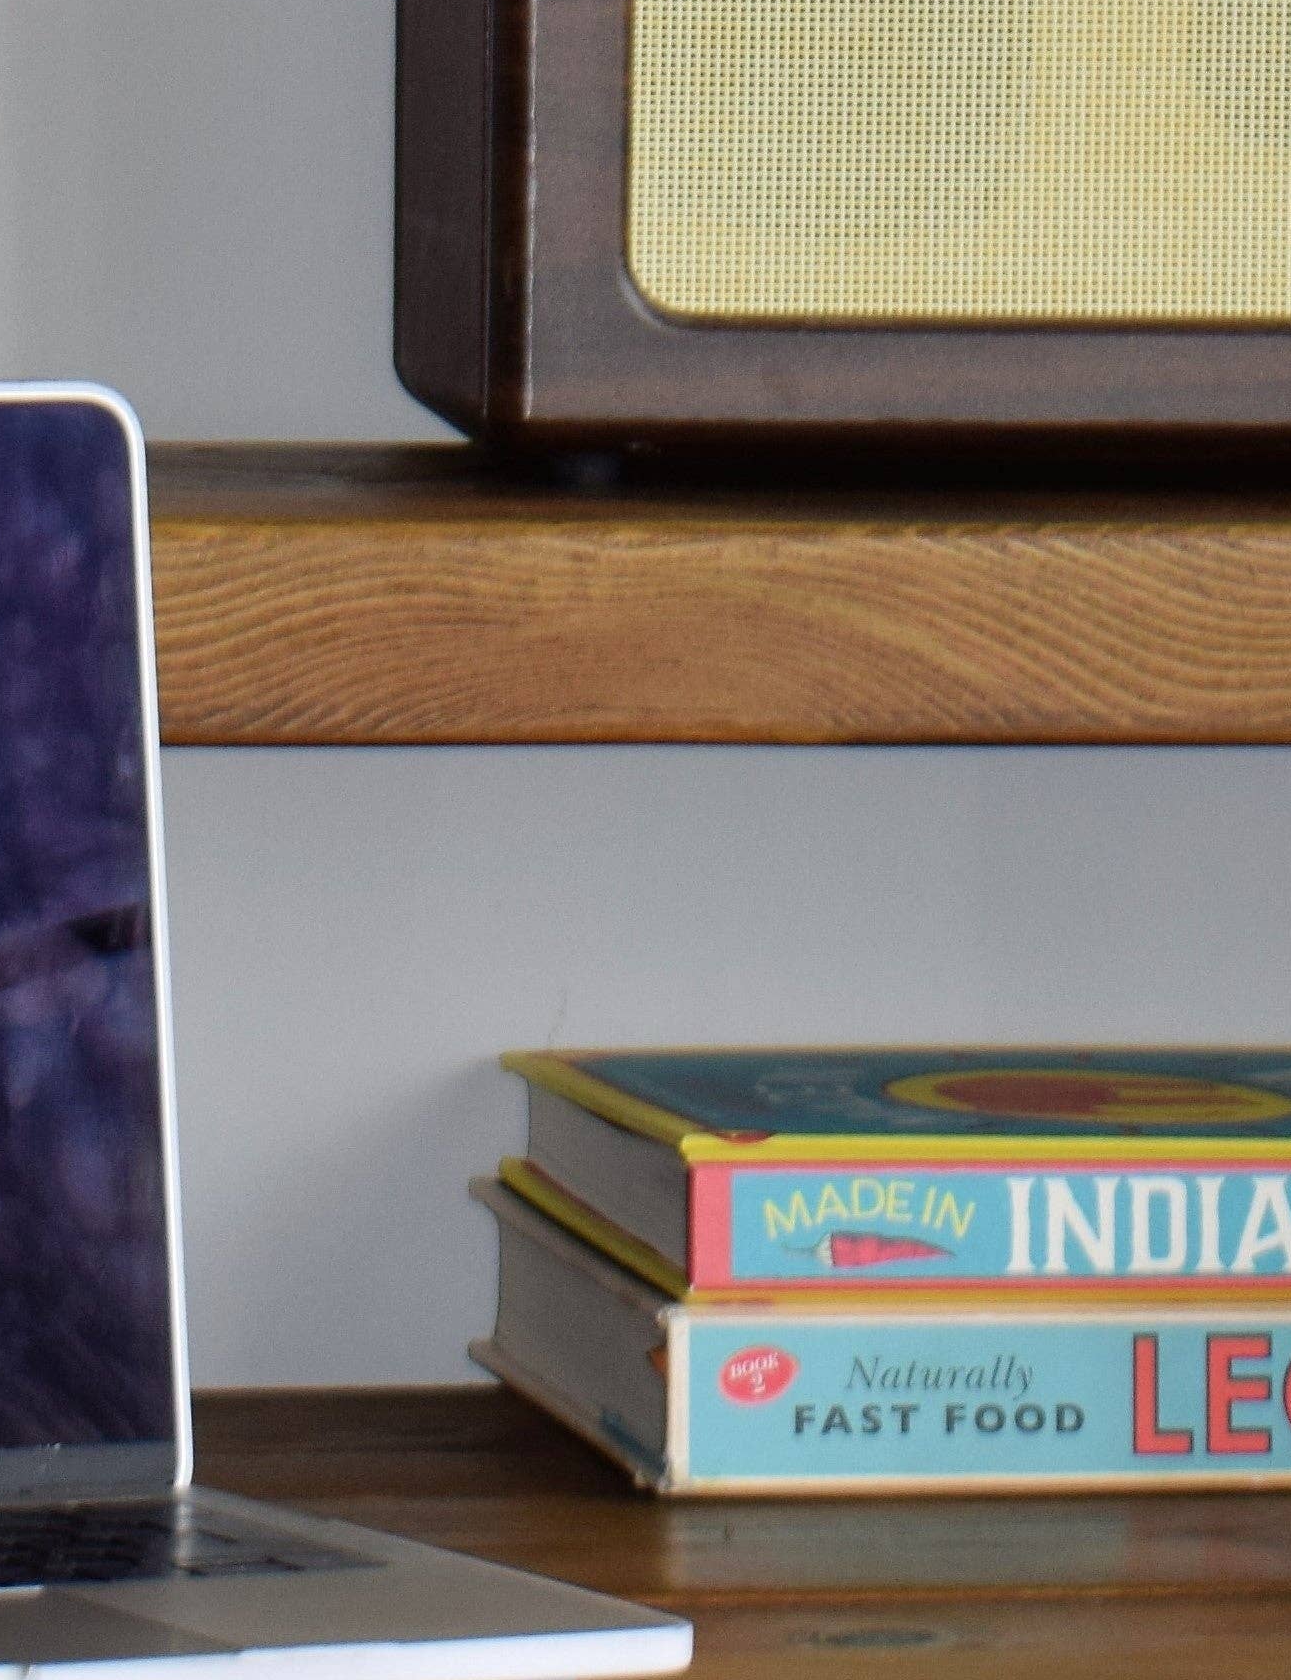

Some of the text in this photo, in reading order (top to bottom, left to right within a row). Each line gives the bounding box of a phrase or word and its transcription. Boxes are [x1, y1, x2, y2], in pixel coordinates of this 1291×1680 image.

[763, 1178, 915, 1240] MADE
[921, 1185, 976, 1239] IN
[730, 1352, 780, 1379] BOOK
[846, 1353, 1034, 1400] Naturally
[794, 1402, 1086, 1434] FAST FOOD
